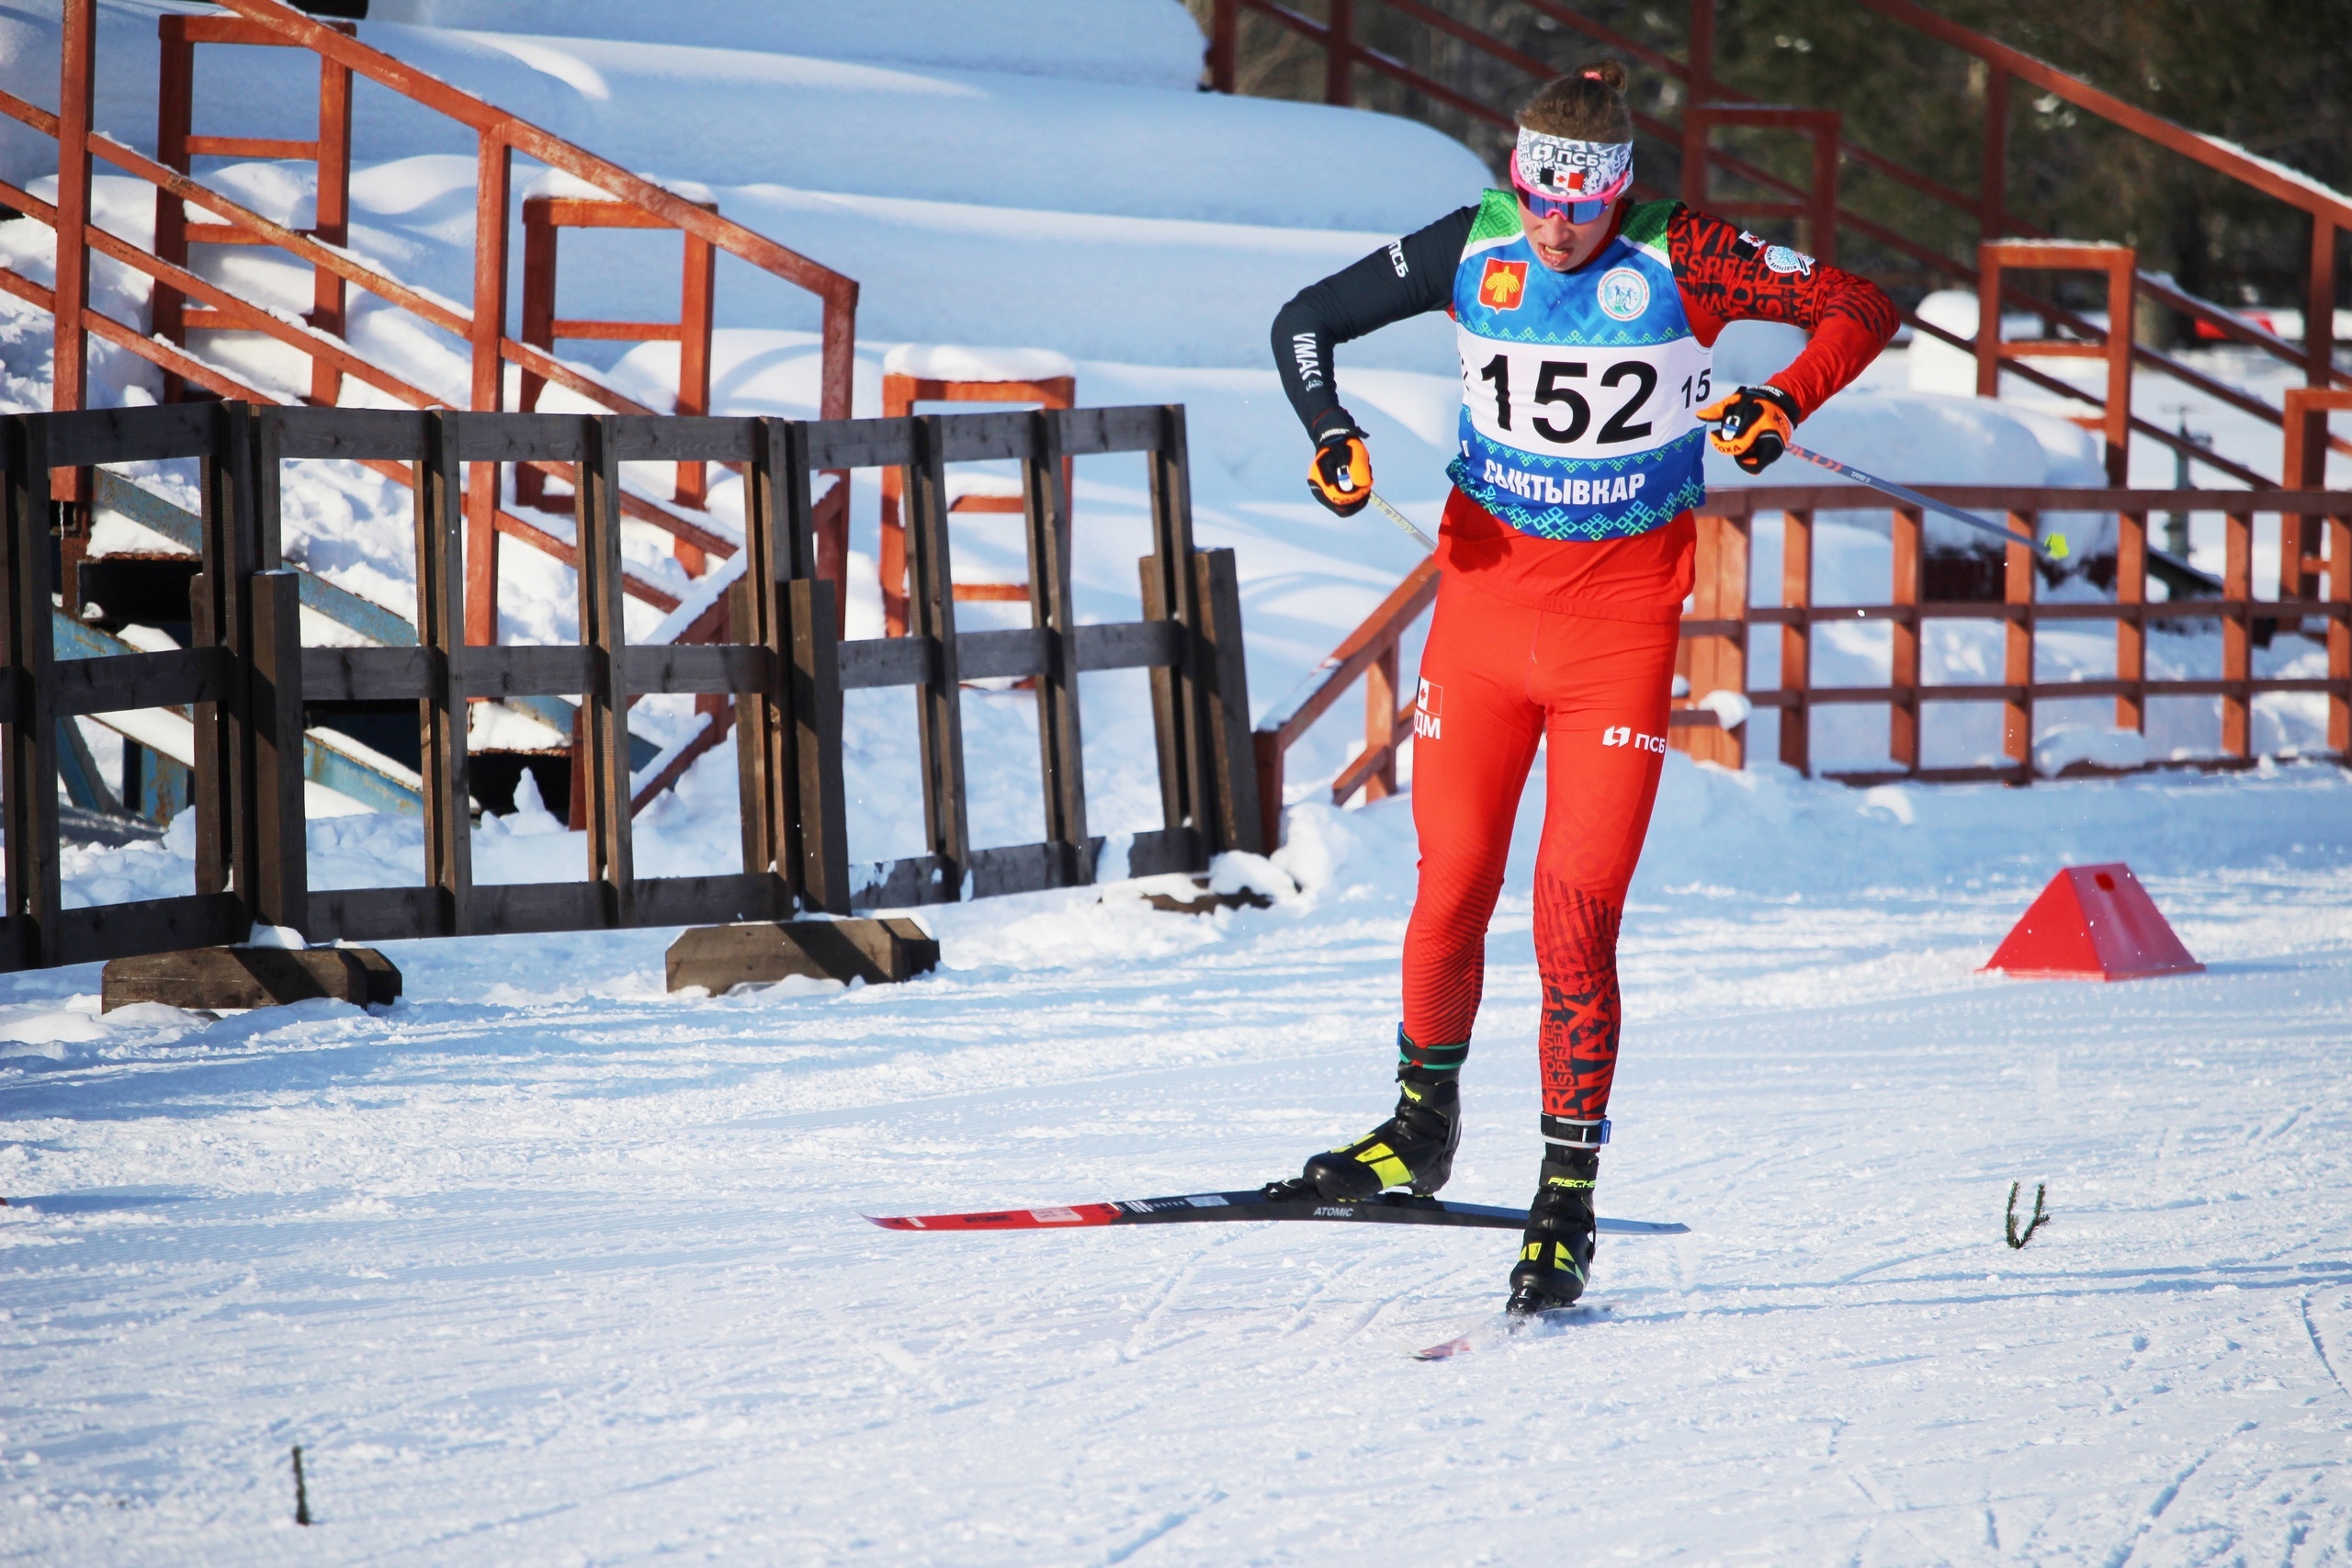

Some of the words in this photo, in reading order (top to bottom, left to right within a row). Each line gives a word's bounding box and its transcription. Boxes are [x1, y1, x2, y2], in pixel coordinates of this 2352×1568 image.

[1556, 150, 1599, 166] ПСБ
[1388, 240, 1408, 278] ПСБ
[1481, 354, 1657, 445] 152
[1483, 458, 1645, 505] СЫКТЫВКАР
[1414, 709, 1441, 740] ДМ
[1634, 733, 1666, 754] ПСБ
[1313, 1206, 1354, 1217] ATOMIC
